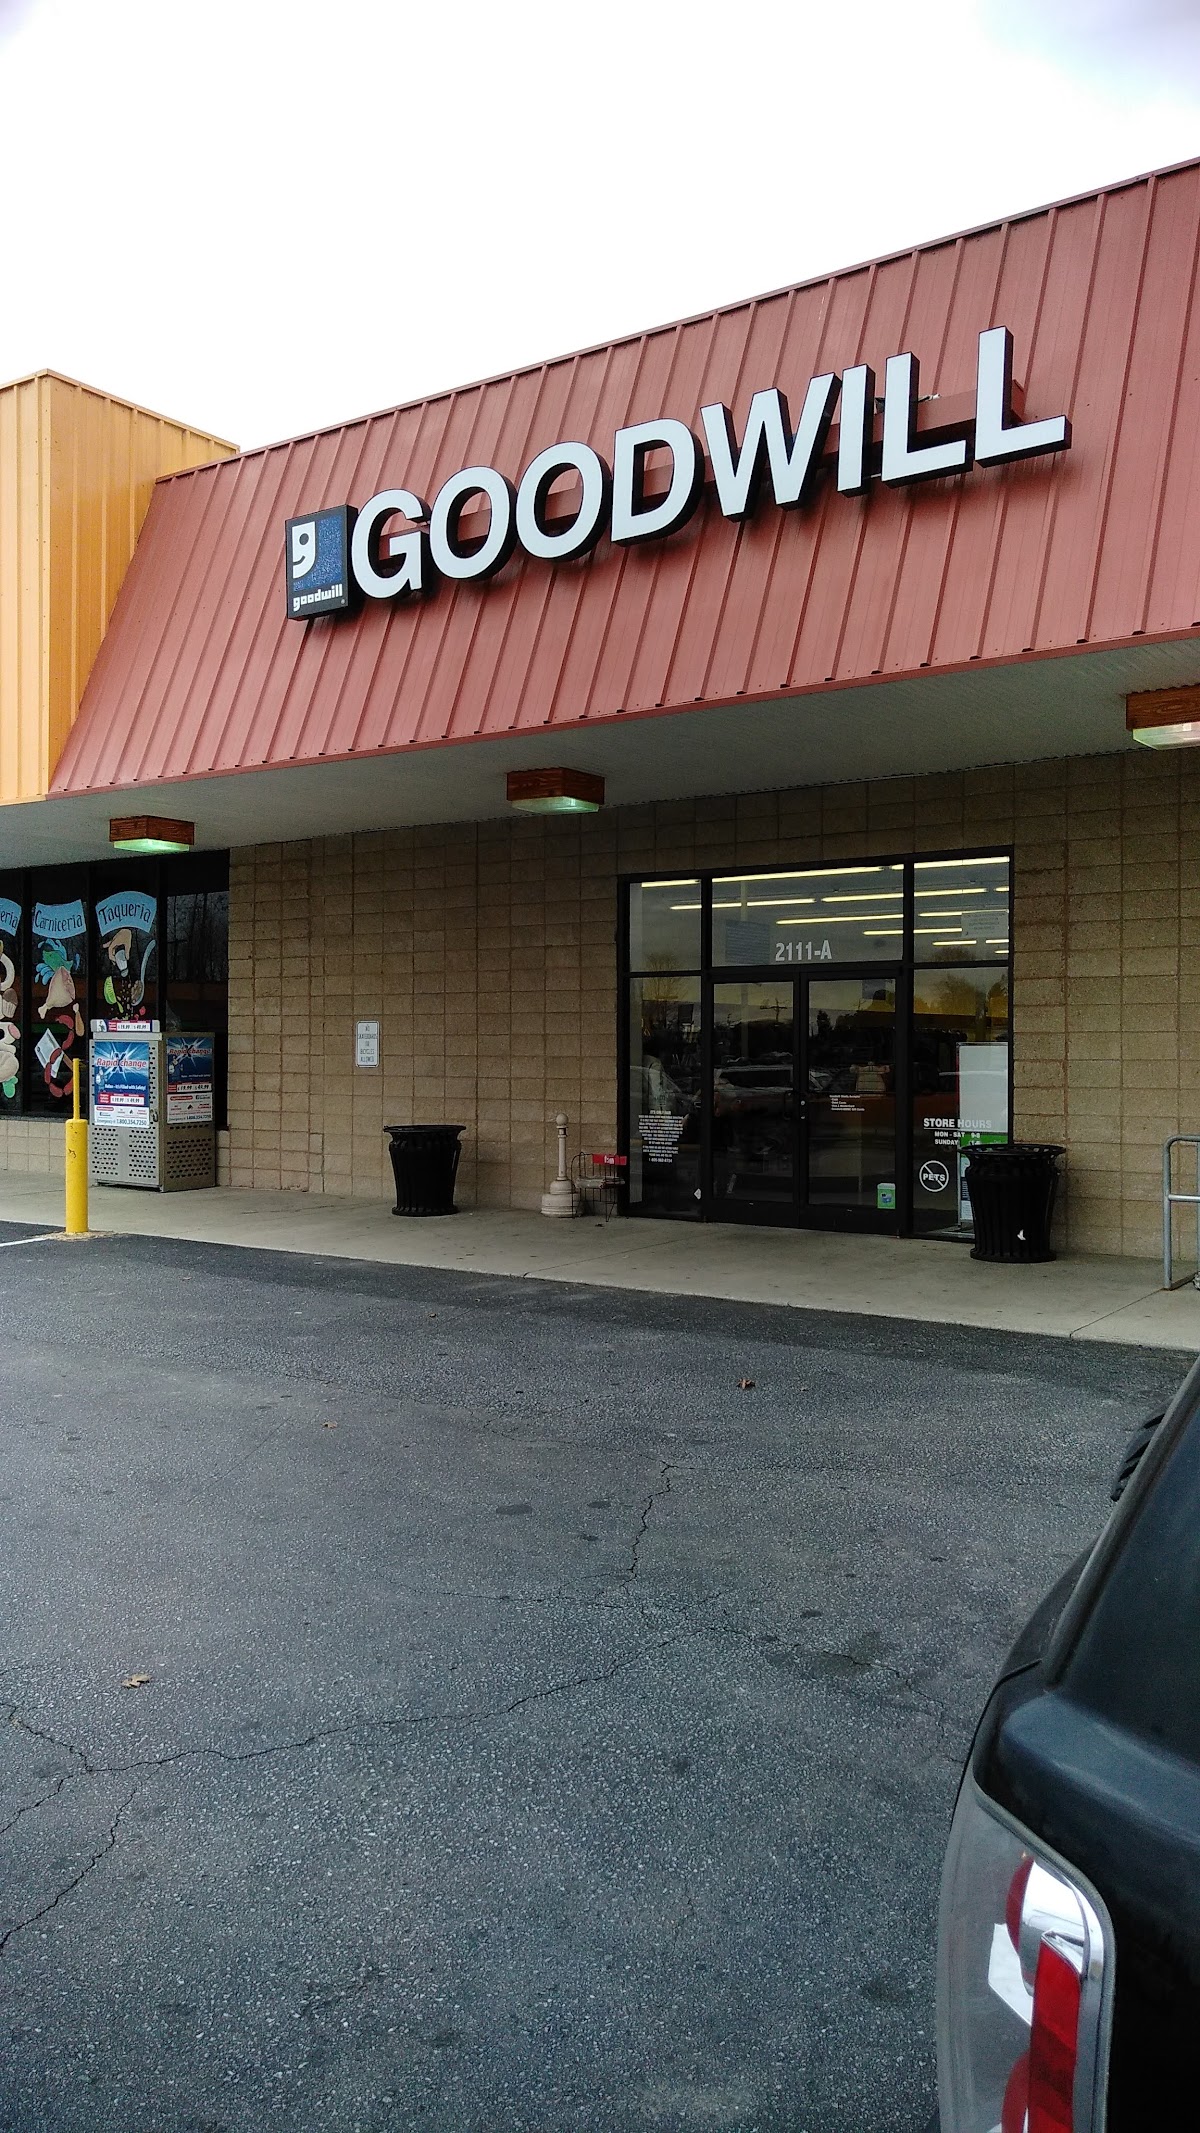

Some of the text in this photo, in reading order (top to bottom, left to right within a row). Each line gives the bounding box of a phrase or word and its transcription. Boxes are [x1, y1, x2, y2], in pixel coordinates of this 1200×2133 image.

[351, 325, 1071, 600] GOODWILL
[293, 583, 343, 612] goodwill
[34, 909, 83, 932] Carniceria
[99, 903, 151, 926] Taqueria
[775, 939, 832, 962] 2111-A
[96, 1057, 118, 1068] Rapid
[169, 1048, 188, 1056] Rapid
[923, 1118, 992, 1129] STORE HOURS
[922, 1173, 946, 1181] PETS
